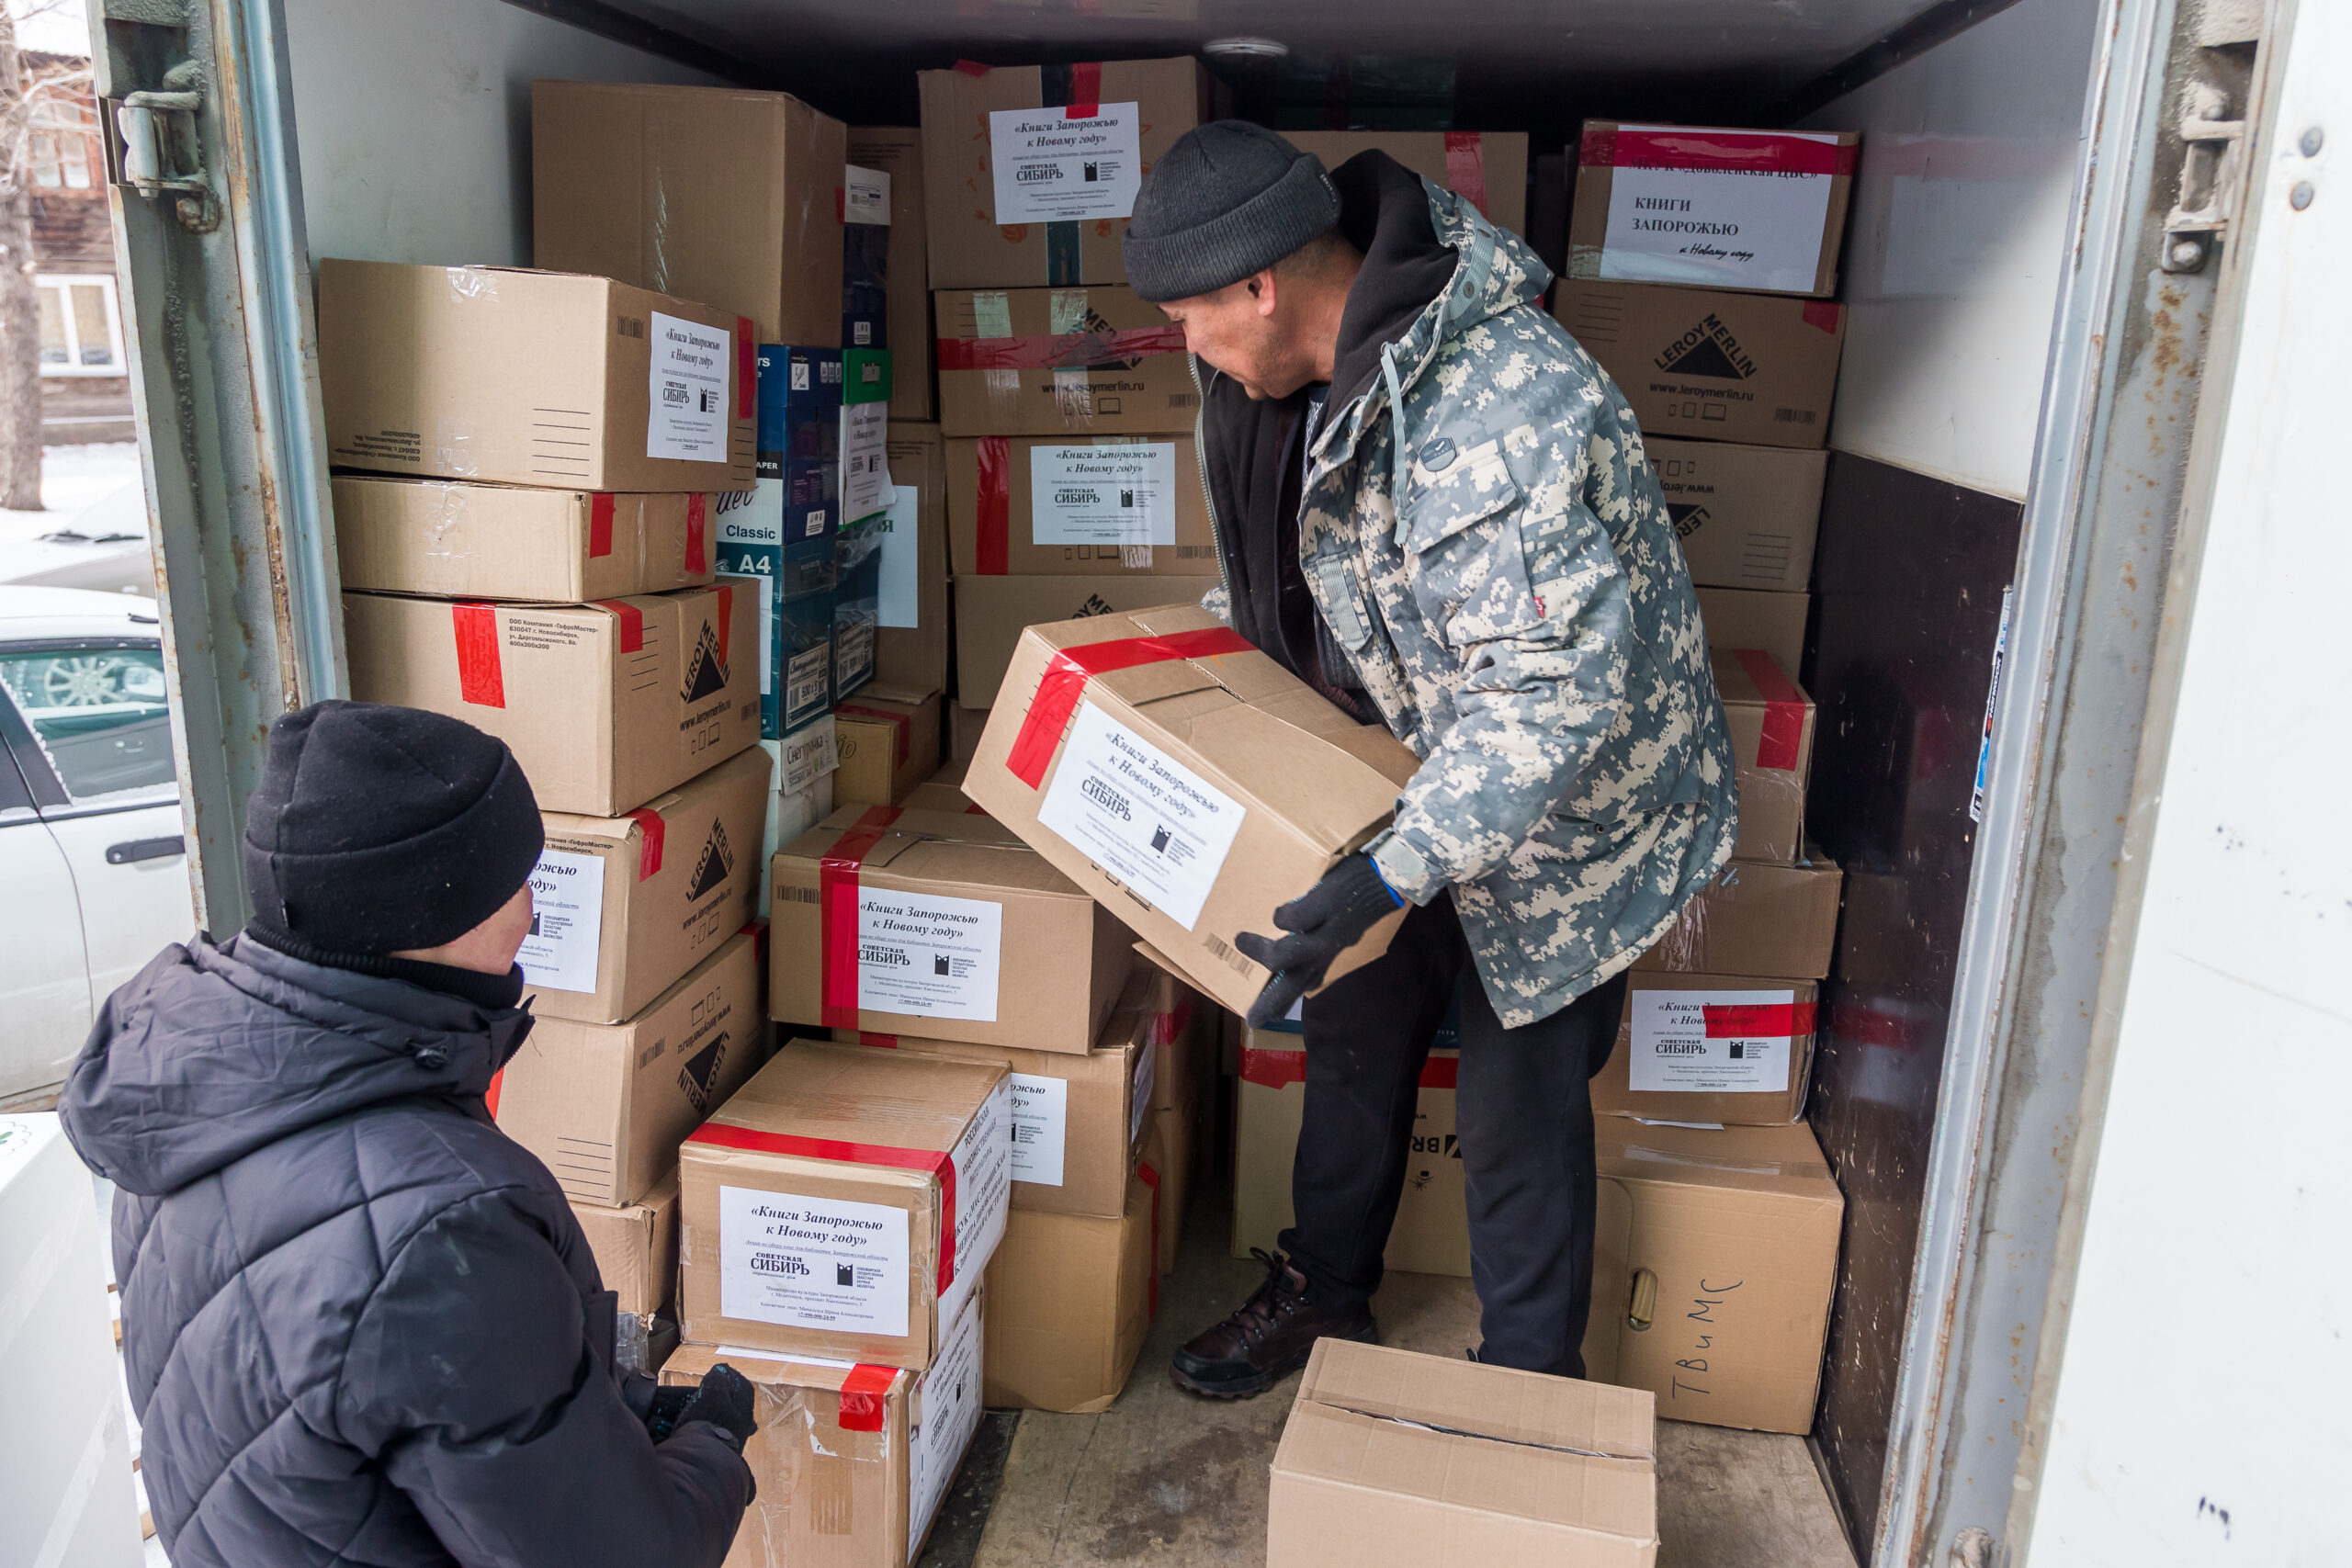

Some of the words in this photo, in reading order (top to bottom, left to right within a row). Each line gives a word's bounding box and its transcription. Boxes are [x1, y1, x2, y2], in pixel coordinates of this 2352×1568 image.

[1014, 122, 1053, 133] «Книги
[1057, 118, 1118, 132] Запорожью
[1036, 136, 1077, 148] Новому
[1079, 134, 1106, 145] году»
[1016, 168, 1064, 182] СИБИРЬ
[1635, 197, 1691, 212] КНИГИ
[1632, 219, 1739, 236] ЗАПОРОЖЬЮ
[666, 328, 687, 344] «Книги
[689, 333, 720, 351] Запорожью
[1654, 322, 1705, 370] LEROY
[1702, 312, 1758, 378] MERLIN
[676, 349, 698, 367] Новому
[663, 388, 690, 404] СИБИРЬ
[1649, 383, 1754, 401] www.leroymerlin.ru
[1057, 450, 1093, 459] «Книги
[1097, 450, 1157, 461] Запорожью
[1075, 464, 1114, 475] Новому
[1116, 464, 1143, 474] году»
[1055, 493, 1101, 503] СИБИРЬ
[726, 525, 776, 540] Classic
[739, 555, 772, 573] A4
[523, 620, 553, 628] Компания
[702, 618, 730, 683] MERIN
[680, 634, 705, 702] LEROY
[680, 699, 731, 731] www.leroymerlin.ru
[787, 735, 823, 764] Снегурочка
[1106, 732, 1148, 765] «Книги
[1148, 759, 1219, 813] Запорожью
[1119, 760, 1164, 797] Новому
[1164, 794, 1195, 819] году»
[1082, 779, 1132, 821] СИБИРЬ
[551, 844, 594, 854] Новосибирск,
[712, 816, 735, 873] MERLIN
[685, 832, 714, 901] LEROY
[527, 878, 557, 893] оду»
[860, 901, 904, 916] «Книги
[907, 906, 978, 926] Запорожью
[873, 919, 879, 928] к
[883, 919, 929, 935] Новому
[932, 927, 964, 940] году»
[858, 949, 910, 966] СИБИРЬ
[863, 944, 904, 953] СОВЕТСКАЯ
[1658, 1002, 1700, 1012] «Книги
[1656, 1043, 1707, 1055] СИБИРЬ
[706, 1031, 730, 1100] LEROY
[1012, 1097, 1029, 1108] ду»
[965, 1106, 989, 1149] РОССИЙСКАЯ
[963, 1118, 997, 1178] ХУДОЖЕСТВЕННАЯ
[752, 1206, 799, 1221] «Книги
[803, 1211, 883, 1231] Запорожью
[766, 1226, 774, 1235] к
[778, 1224, 829, 1243] Новому
[831, 1233, 867, 1247] году»
[756, 1252, 802, 1263] СОВЕТСКАЯ
[751, 1258, 810, 1276] СИБИРЬ
